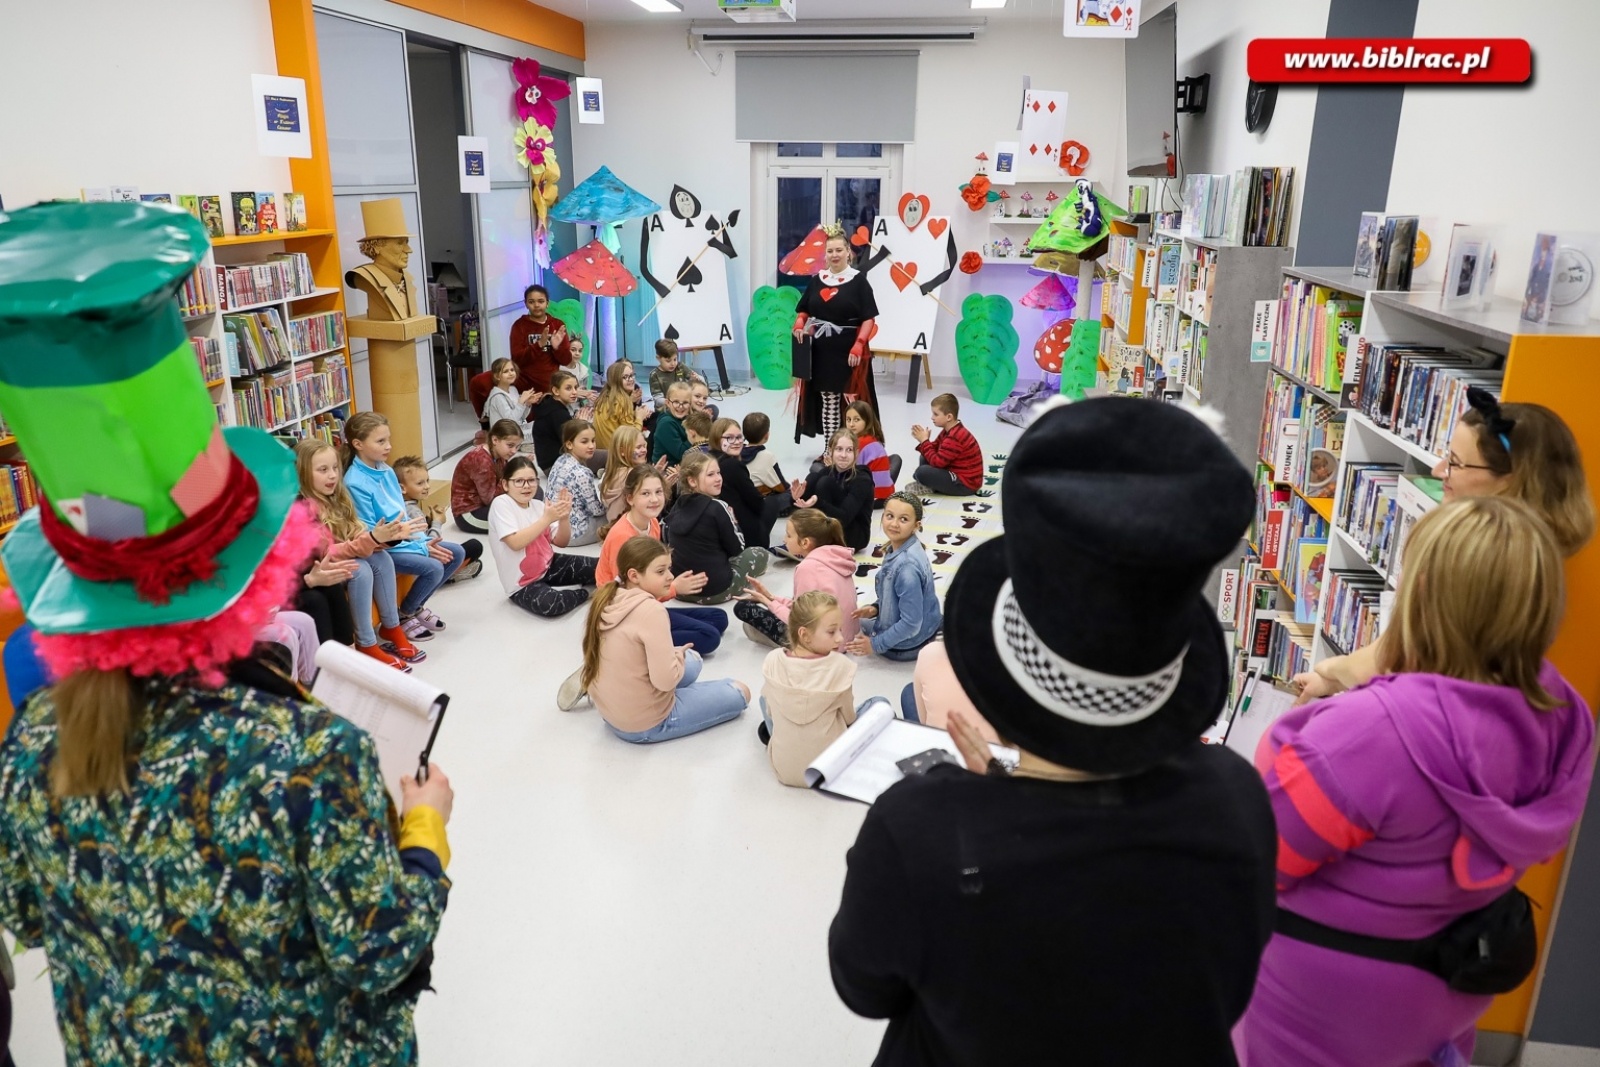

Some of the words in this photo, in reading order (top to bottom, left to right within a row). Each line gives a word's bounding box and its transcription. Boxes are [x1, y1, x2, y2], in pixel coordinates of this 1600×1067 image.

[1124, 17, 1133, 31] K
[650, 213, 665, 232] A
[874, 218, 888, 236] A
[217, 273, 226, 303] MANGA
[719, 323, 732, 341] A
[1262, 303, 1271, 342] PLASTYCZNE
[913, 332, 928, 350] A
[1356, 336, 1366, 355] DVD
[1180, 349, 1189, 383] DINOZAURY
[1352, 357, 1363, 382] FILMY
[1282, 444, 1294, 481] RYSUNEK
[1265, 523, 1273, 554] ZWYCZAJE
[1273, 523, 1281, 552] OBYCZAJE
[1223, 571, 1235, 603] SPORT
[1255, 622, 1270, 655] NETFLIX
